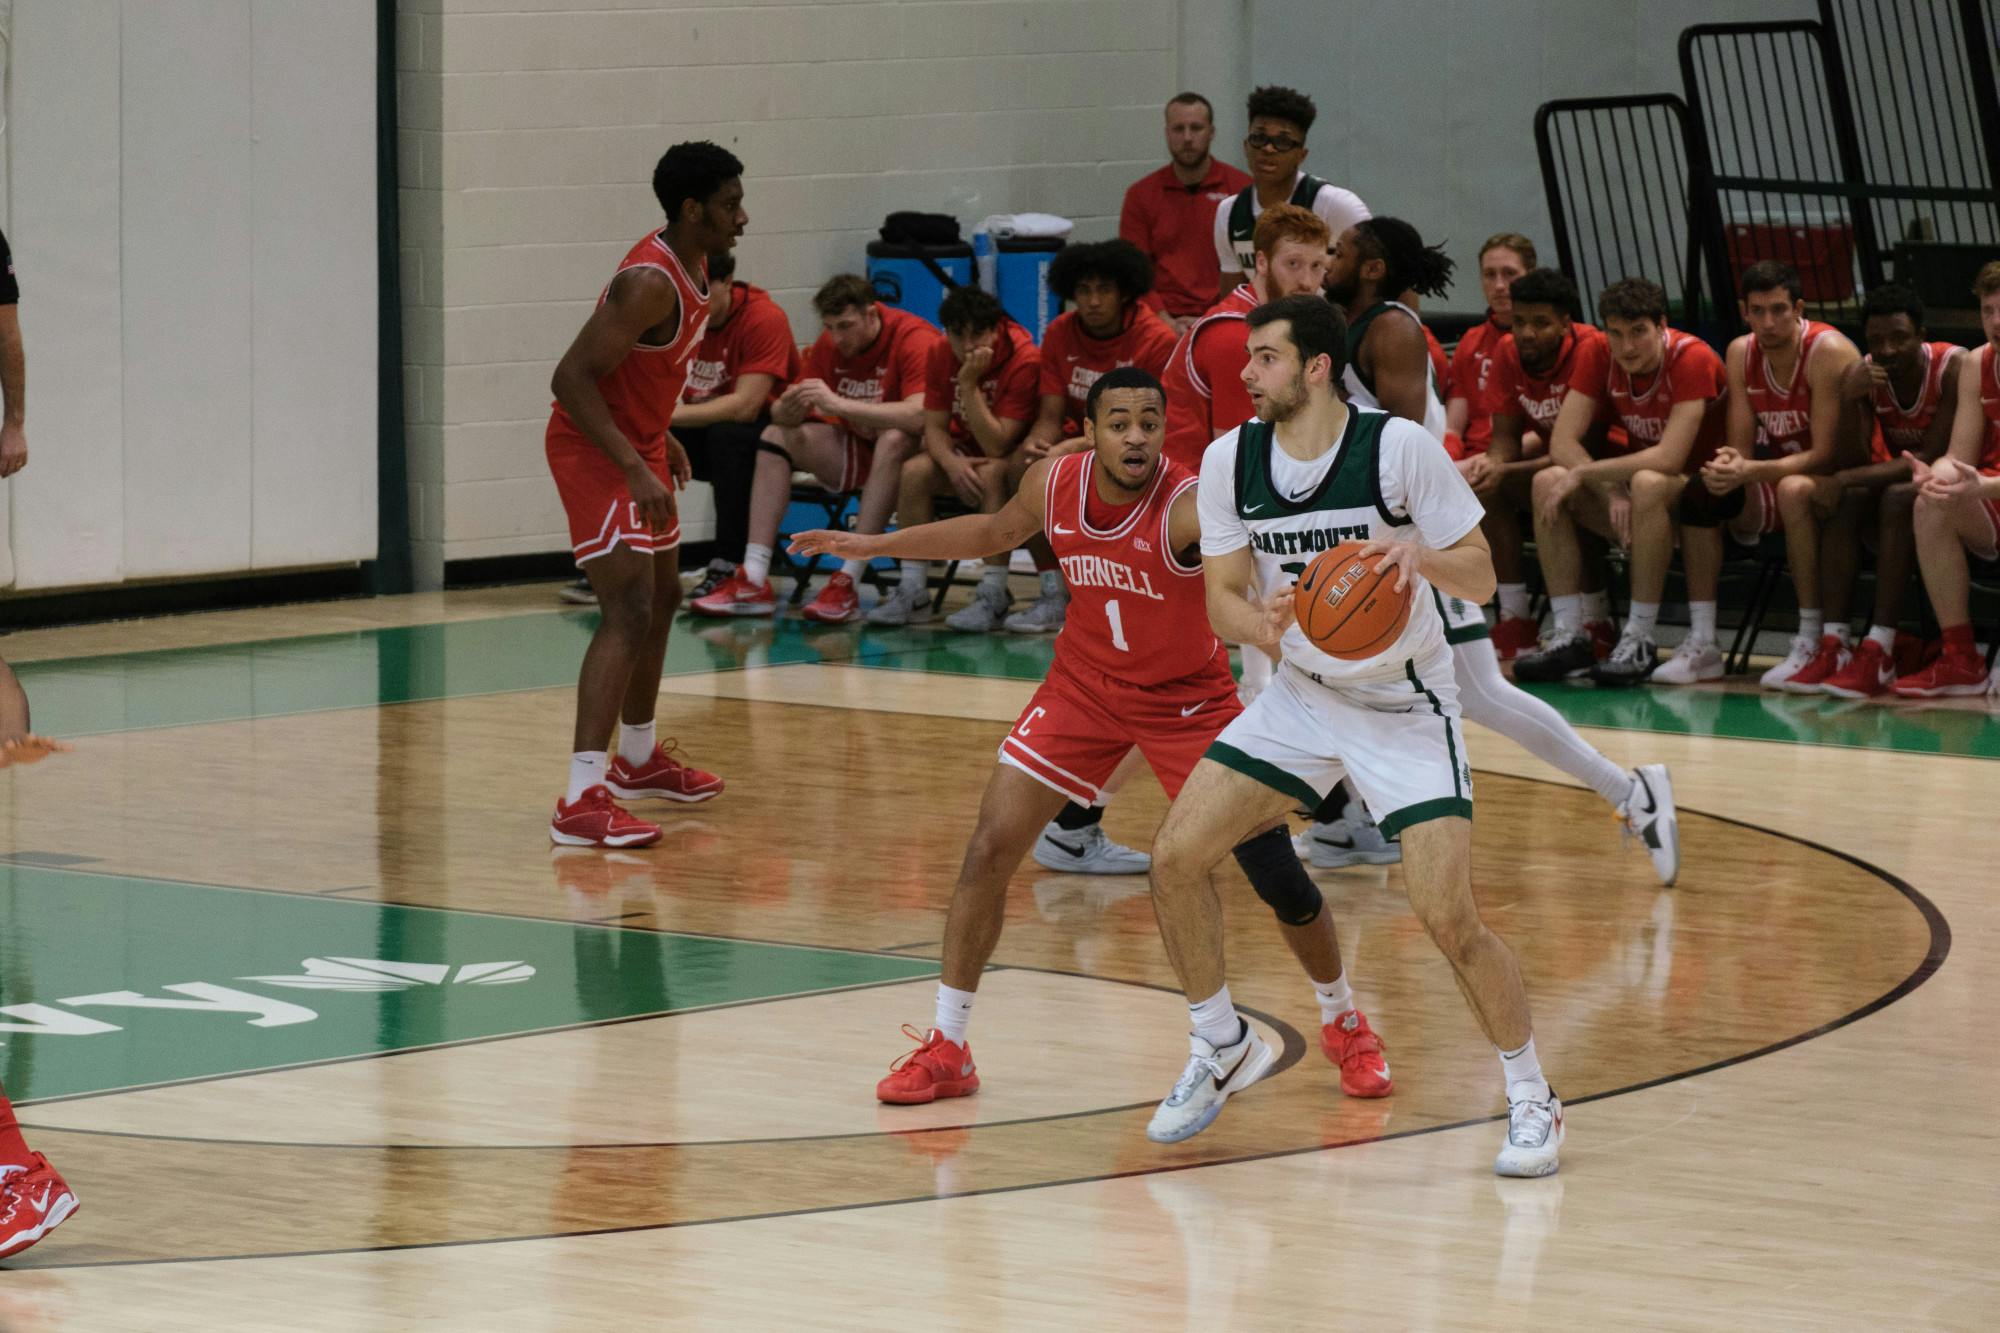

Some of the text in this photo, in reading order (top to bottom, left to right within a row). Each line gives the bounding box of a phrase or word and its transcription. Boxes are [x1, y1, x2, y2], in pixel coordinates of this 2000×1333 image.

[1058, 554, 1165, 601] CORNELL
[1324, 560, 1369, 608] ELITE
[1104, 599, 1130, 653] 1
[1017, 706, 1047, 737] C
